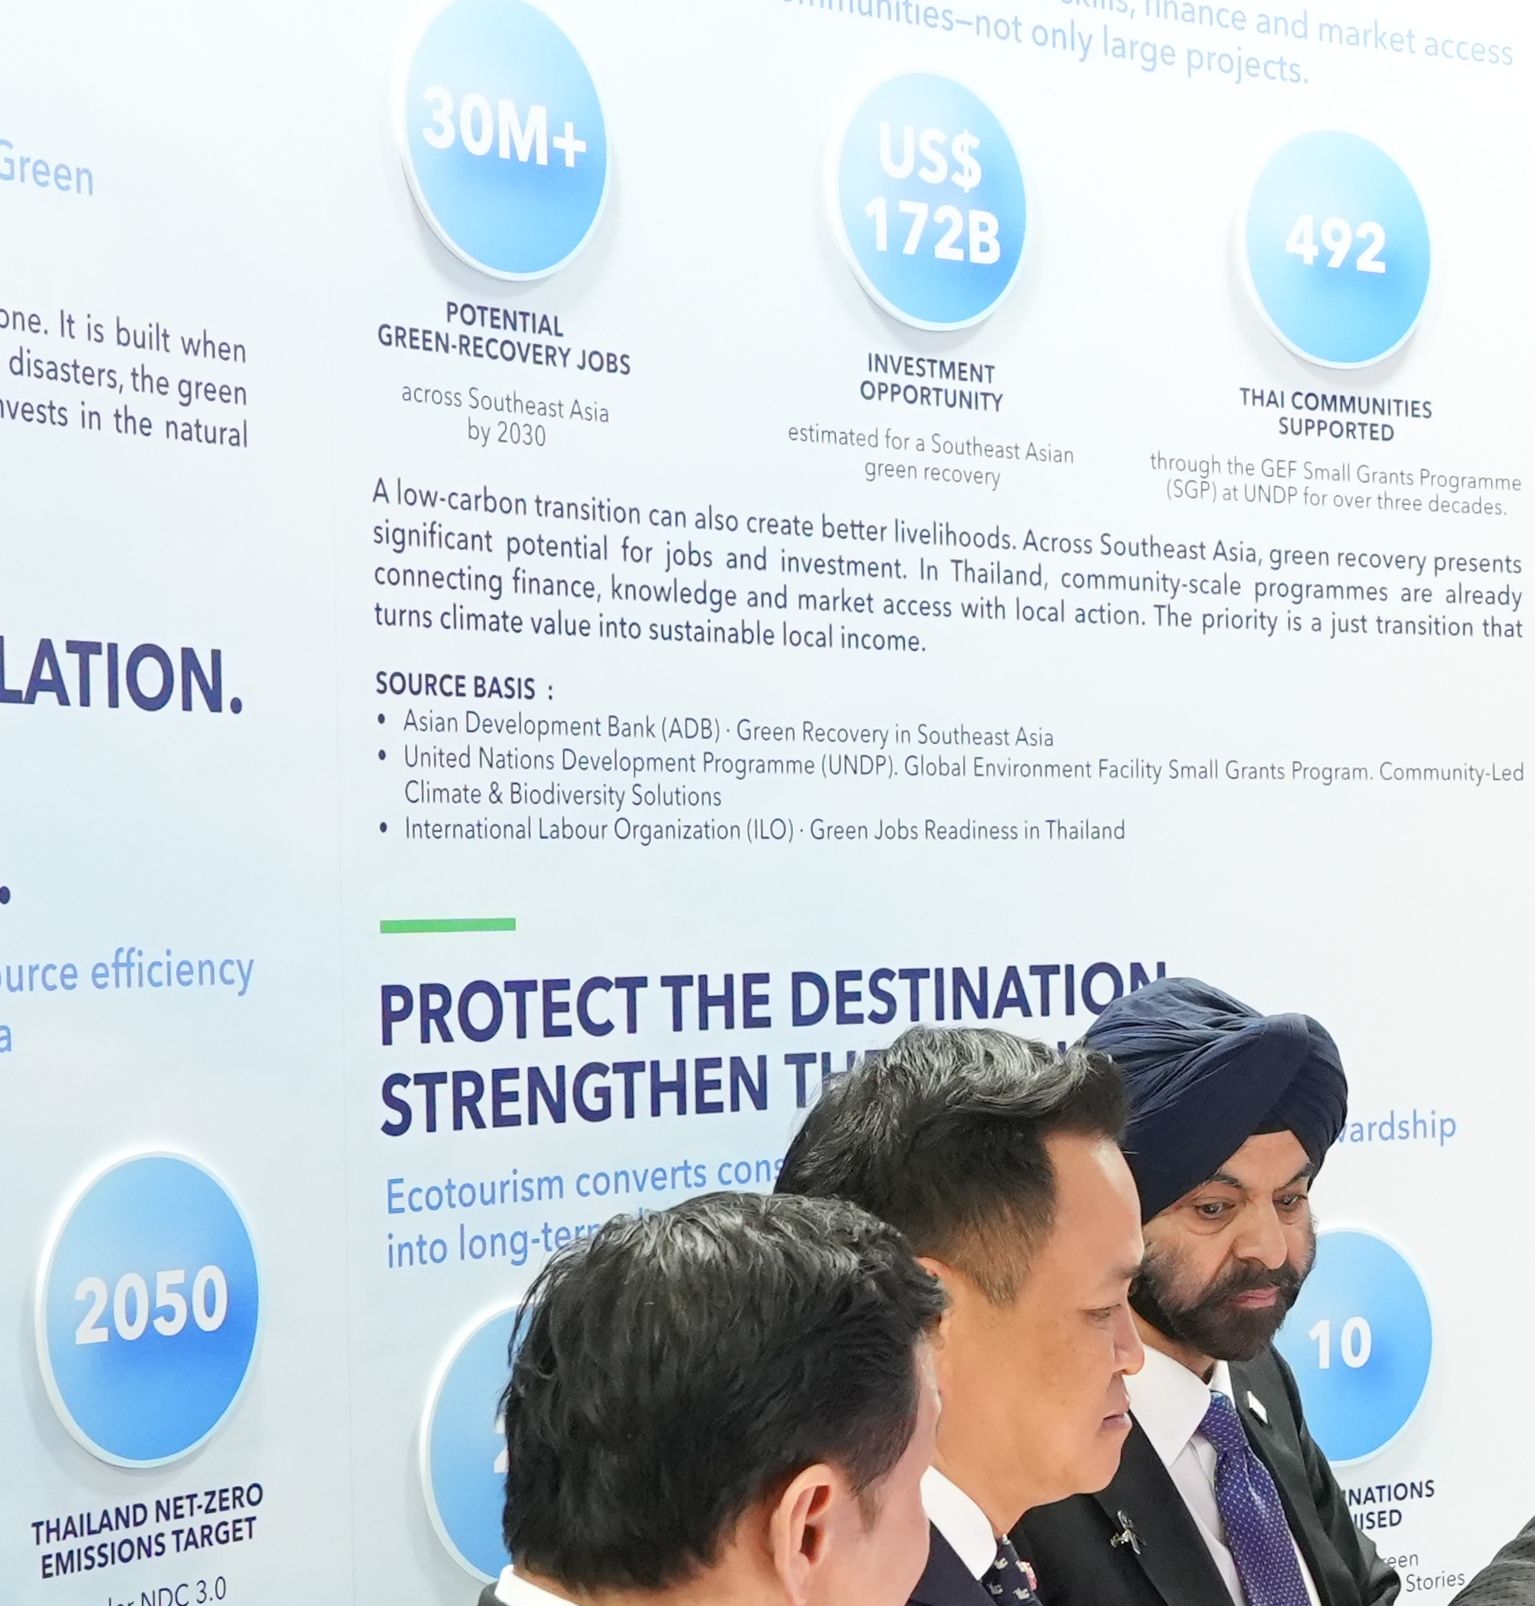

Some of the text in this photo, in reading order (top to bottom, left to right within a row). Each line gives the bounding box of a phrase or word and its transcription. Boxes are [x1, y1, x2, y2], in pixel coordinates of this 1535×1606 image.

[422, 85, 588, 169] 30M+
[879, 122, 983, 194] US$
[865, 197, 1002, 265] 172B
[1285, 216, 1387, 274] 492
[59, 308, 76, 340] It
[86, 313, 105, 344] is
[116, 315, 171, 354] built
[180, 328, 247, 364] when
[446, 300, 565, 338] POTENTIAL
[377, 323, 631, 376] GREEN-RECOVERY JOBS
[868, 352, 996, 385] INVESTMENT
[401, 385, 609, 423] across Southeast Asia
[859, 379, 1004, 413] OPPORTUNITY
[1239, 387, 1433, 420] THAI COMMUNITIES
[80, 400, 248, 448] in the natural
[467, 415, 546, 449] by 2030
[1278, 416, 1395, 442] SUPPORTED
[375, 670, 536, 701] SOURCE BASIS
[90, 946, 255, 997] efficiency
[380, 975, 648, 1047] PROTECT
[659, 972, 772, 1034] THE
[380, 1054, 768, 1137] STRENGTHEN
[387, 1159, 707, 1215] Ecotourism converts
[387, 1232, 448, 1269] into
[74, 1264, 228, 1346] 2050
[1308, 1316, 1372, 1370] 10
[30, 1482, 264, 1546] THAILAND NET-ZERO
[41, 1515, 257, 1580] EMISSIONS TARGET
[195, 1575, 227, 1605] 3.0
